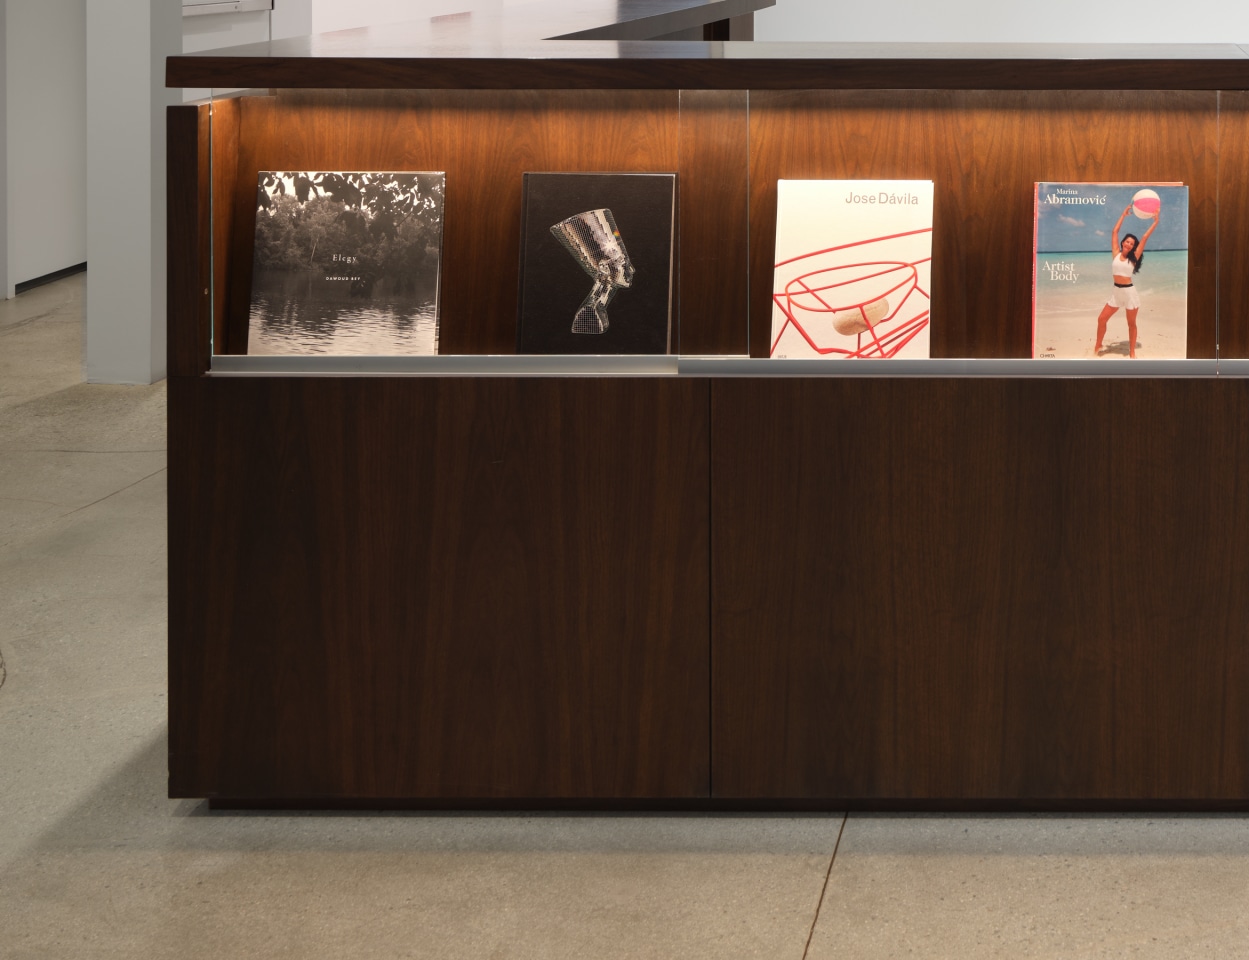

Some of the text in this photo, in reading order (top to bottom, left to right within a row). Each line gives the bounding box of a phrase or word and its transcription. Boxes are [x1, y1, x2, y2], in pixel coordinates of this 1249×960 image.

[845, 192, 919, 205] Jose Dávila
[1043, 193, 1107, 206] Abramović
[332, 253, 358, 264] Elegy
[1042, 260, 1075, 272] Artist
[1050, 270, 1080, 284] Body
